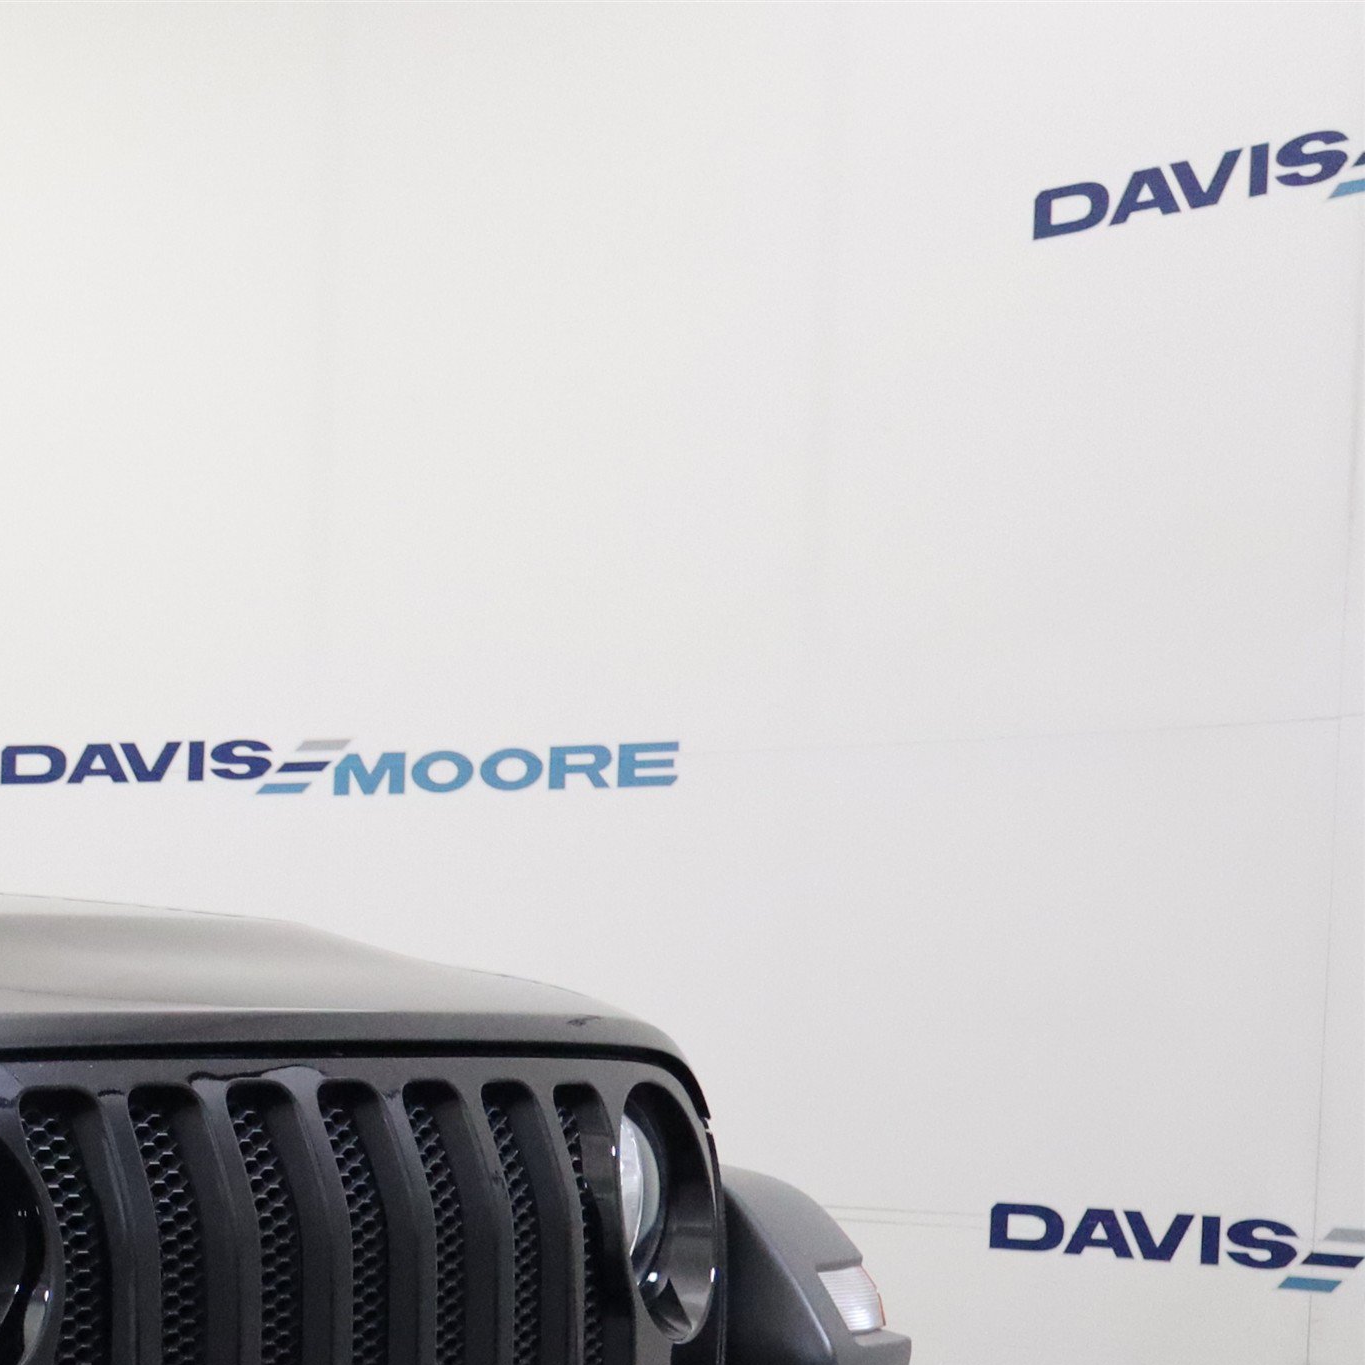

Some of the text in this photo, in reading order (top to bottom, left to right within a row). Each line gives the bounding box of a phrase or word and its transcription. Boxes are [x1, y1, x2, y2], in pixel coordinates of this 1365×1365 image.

[1032, 130, 1350, 241] DAVIS
[0, 740, 680, 796] DAVIS MOORE
[989, 1202, 1299, 1269] DAVIS
